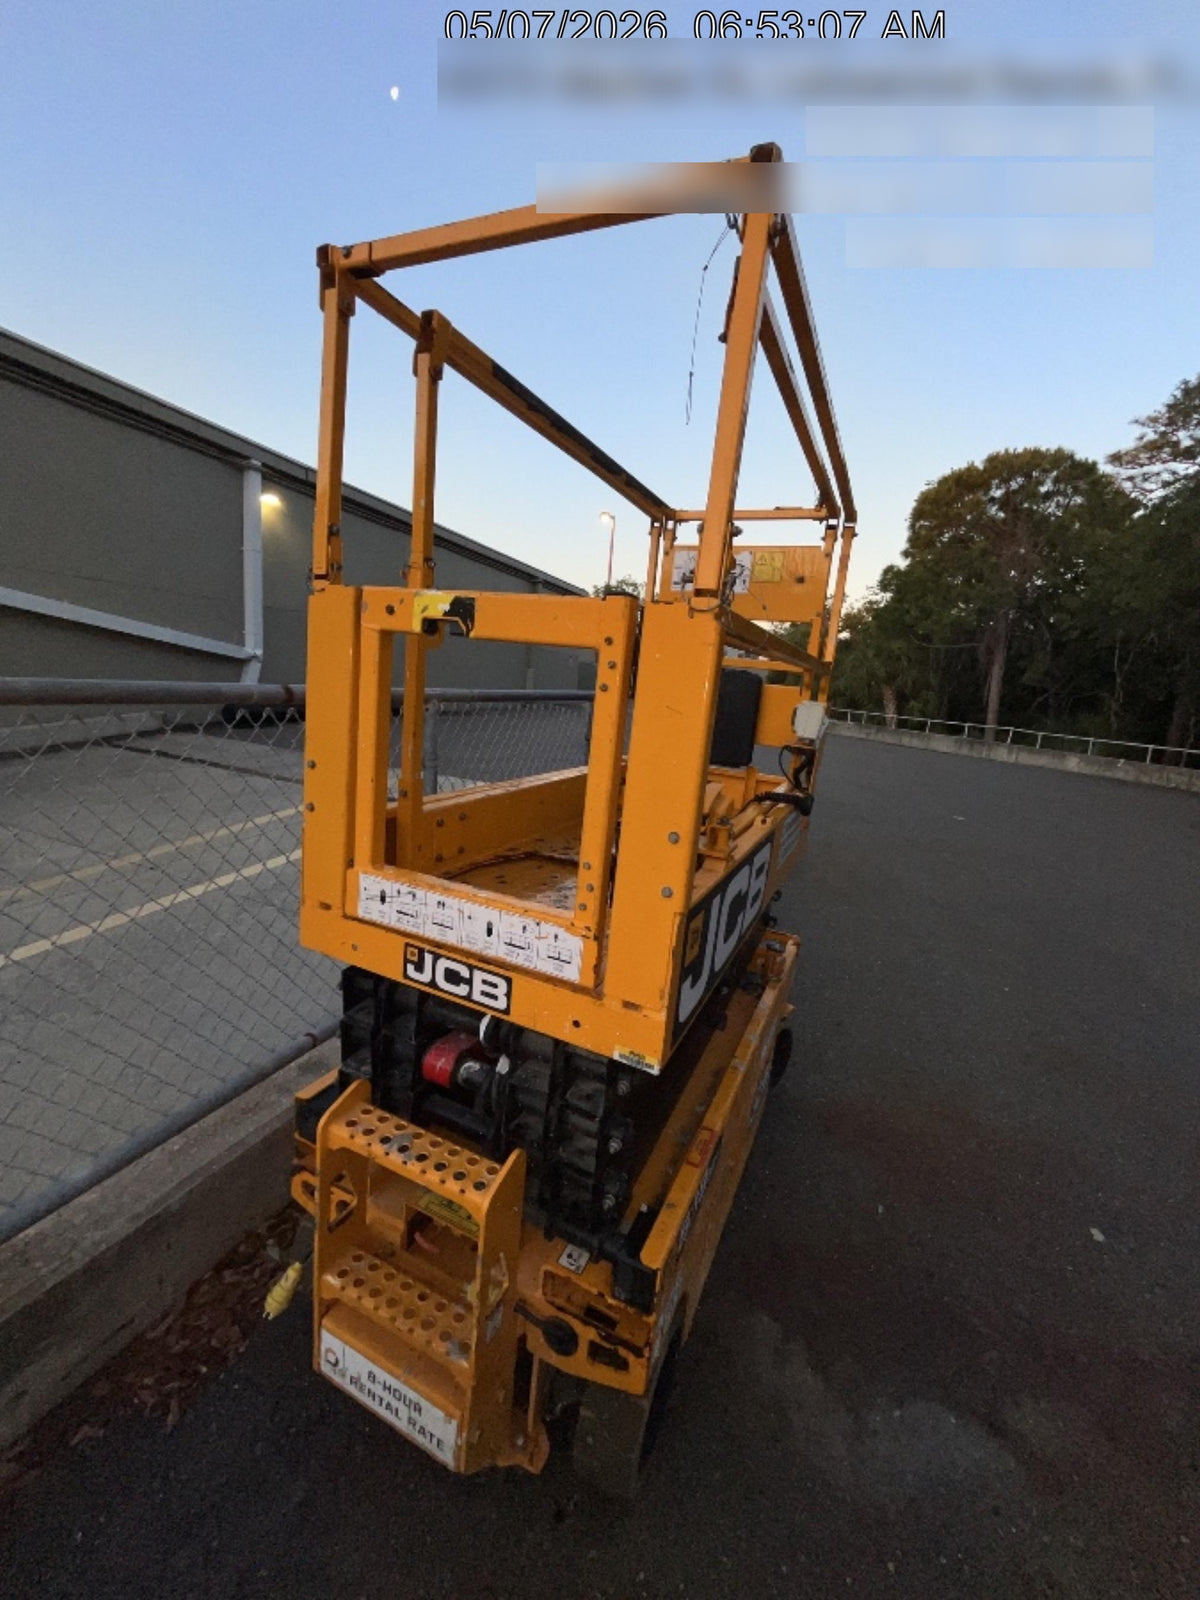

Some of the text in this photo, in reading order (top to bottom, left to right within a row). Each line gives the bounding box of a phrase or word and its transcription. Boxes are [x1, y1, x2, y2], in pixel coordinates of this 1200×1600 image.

[678, 841, 772, 1023] JCB
[405, 945, 509, 1012] JCB
[349, 1375, 446, 1450] RENTAL RATE
[367, 1369, 422, 1417] 8-HOUR
